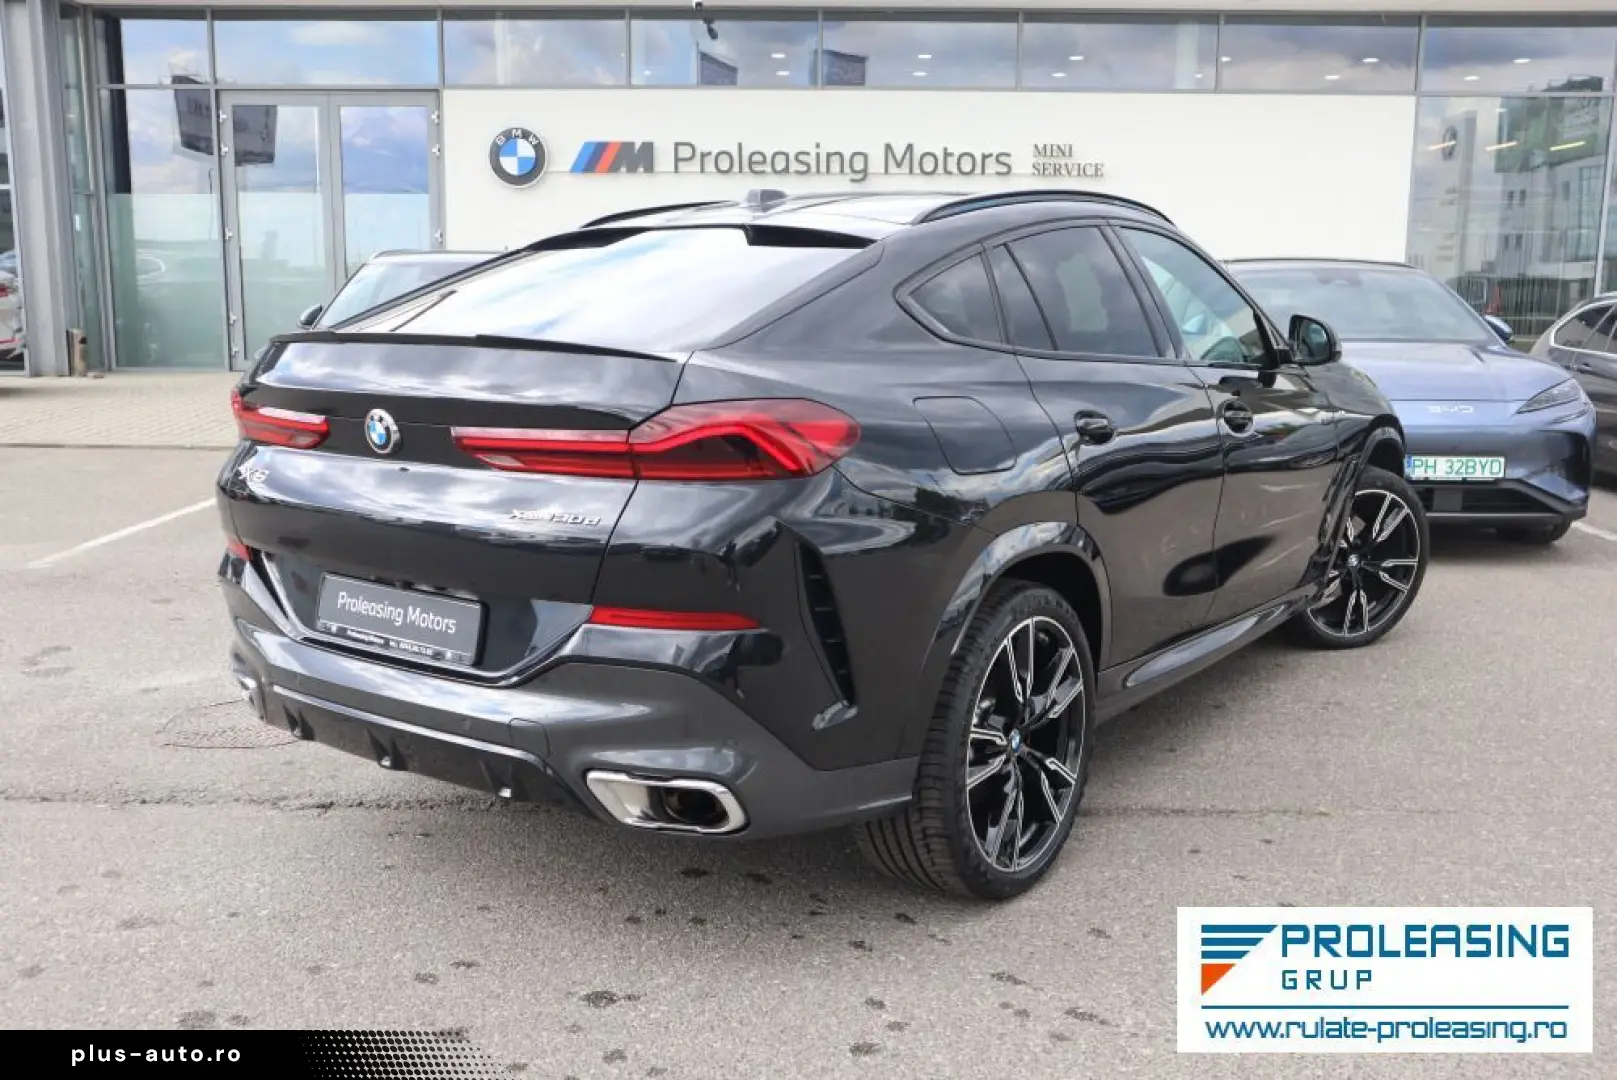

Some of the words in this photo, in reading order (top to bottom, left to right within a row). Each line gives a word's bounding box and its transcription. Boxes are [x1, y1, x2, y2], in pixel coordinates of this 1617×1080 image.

[1033, 143, 1073, 158] MINI
[673, 142, 869, 182] Proleasing
[883, 142, 1012, 175] Motors
[1031, 162, 1104, 177] SERVICE
[1413, 459, 1437, 475] PH
[1445, 459, 1502, 475] 32BYD
[337, 591, 404, 625] Proleasing
[406, 605, 457, 634] Motors
